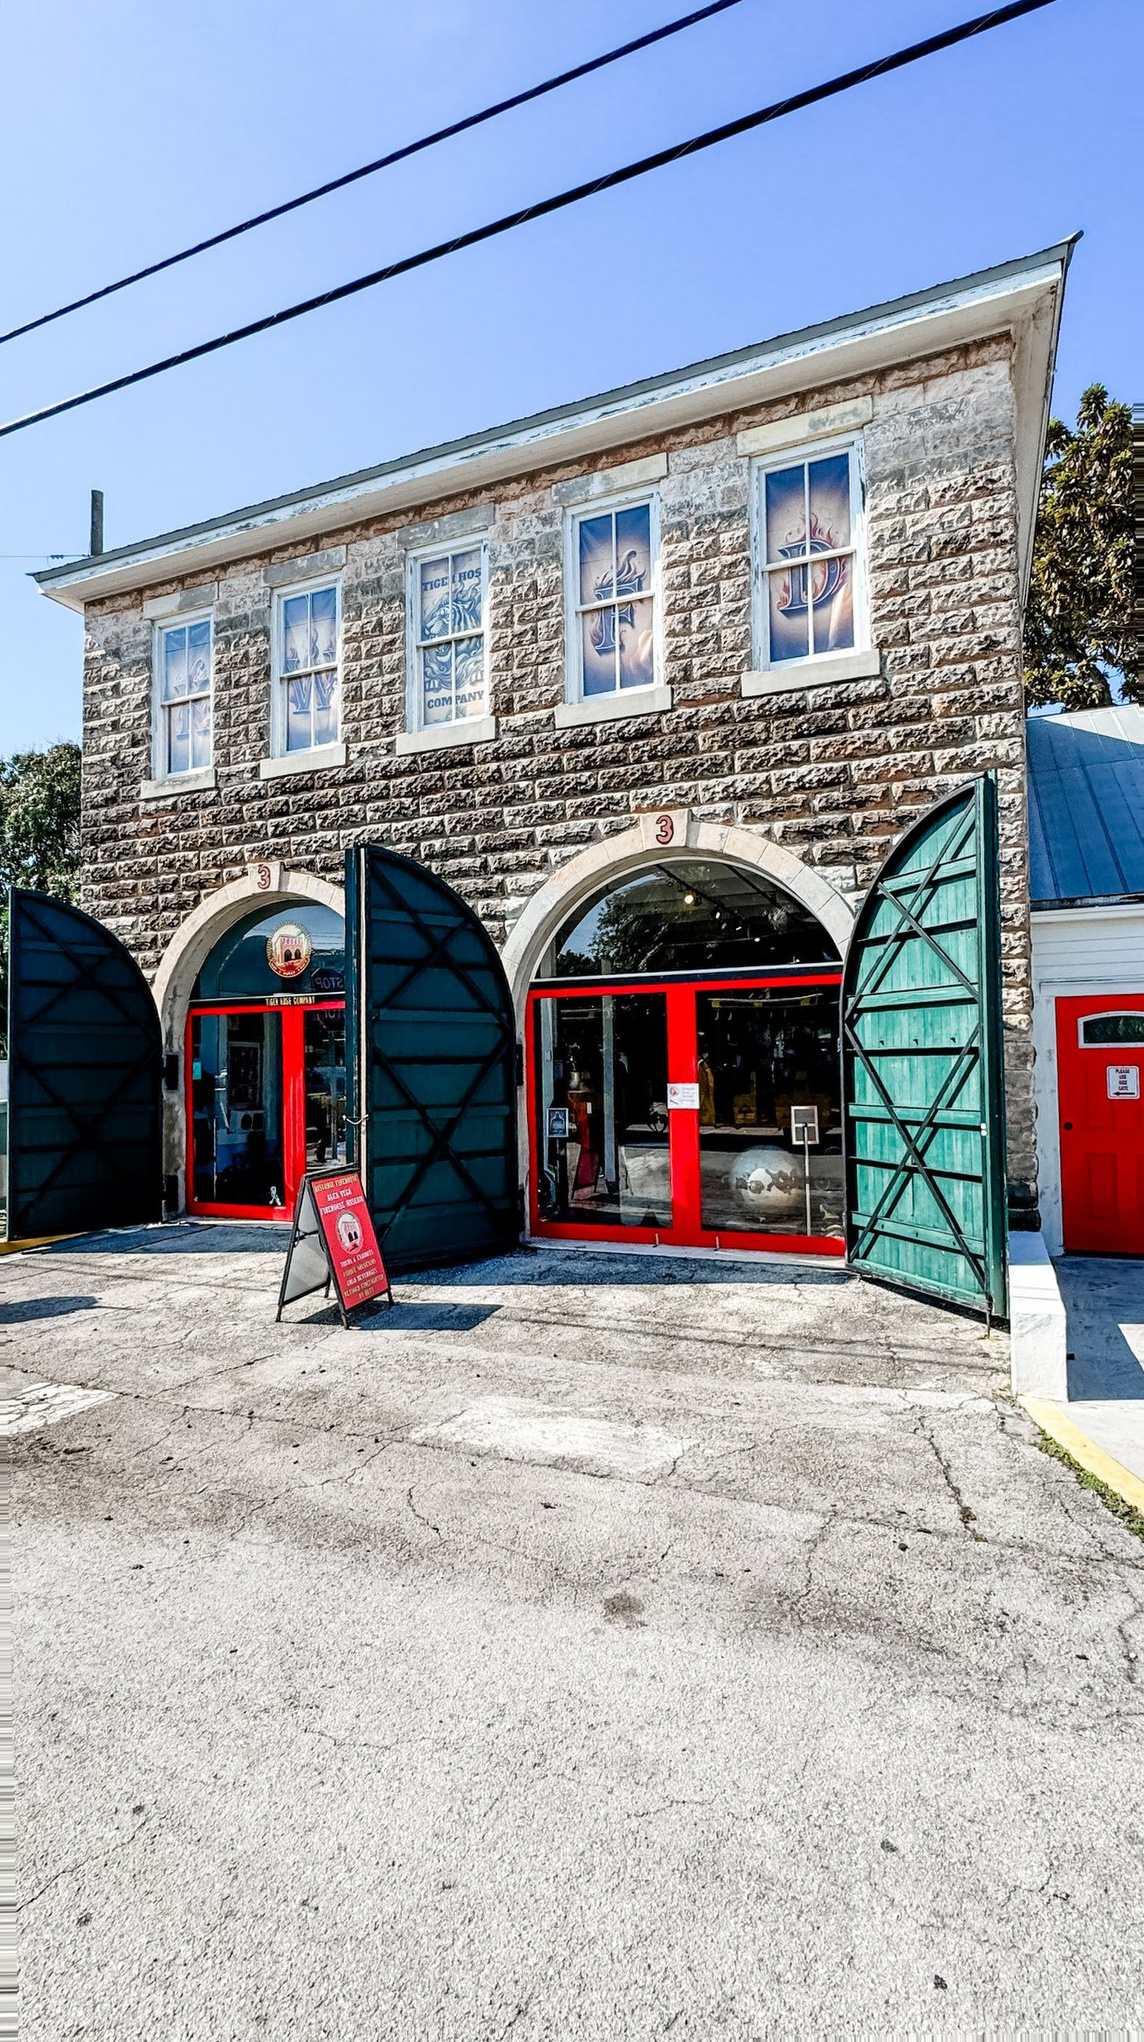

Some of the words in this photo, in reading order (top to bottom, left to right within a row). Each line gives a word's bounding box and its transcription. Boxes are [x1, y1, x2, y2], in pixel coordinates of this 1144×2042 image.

[422, 574, 456, 592] TIGE
[459, 567, 482, 584] HOS
[777, 539, 842, 617] D
[427, 690, 484, 710] COMPANY
[656, 815, 674, 845] 3
[257, 865, 271, 890] 3
[327, 1192, 339, 1201] ALEX
